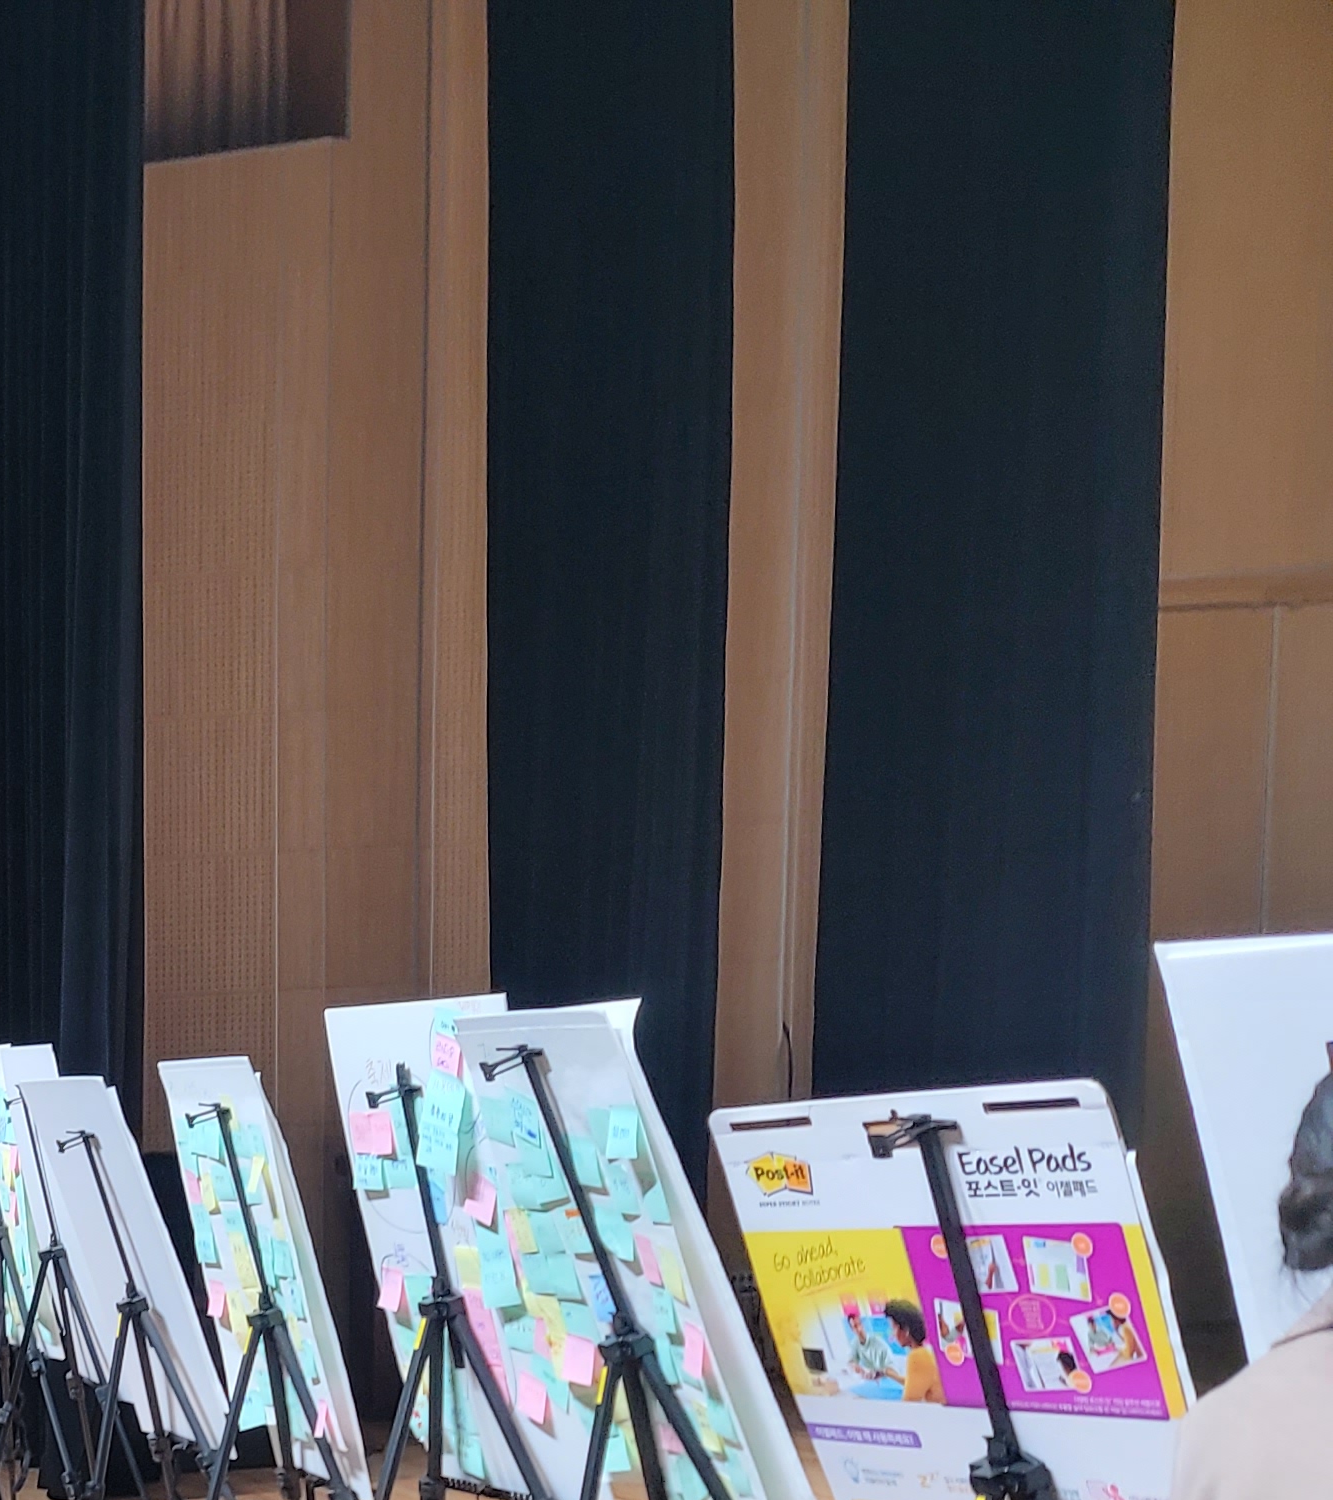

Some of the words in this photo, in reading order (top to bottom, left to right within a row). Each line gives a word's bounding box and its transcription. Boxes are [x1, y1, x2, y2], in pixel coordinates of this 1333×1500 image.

[957, 1145, 1025, 1175] Easel
[1027, 1142, 1093, 1174] Pads
[753, 1162, 806, 1182] Post-it
[1046, 1179, 1099, 1198] 이젤패드
[773, 1251, 791, 1272] Go
[793, 1256, 867, 1292] Collaborate
